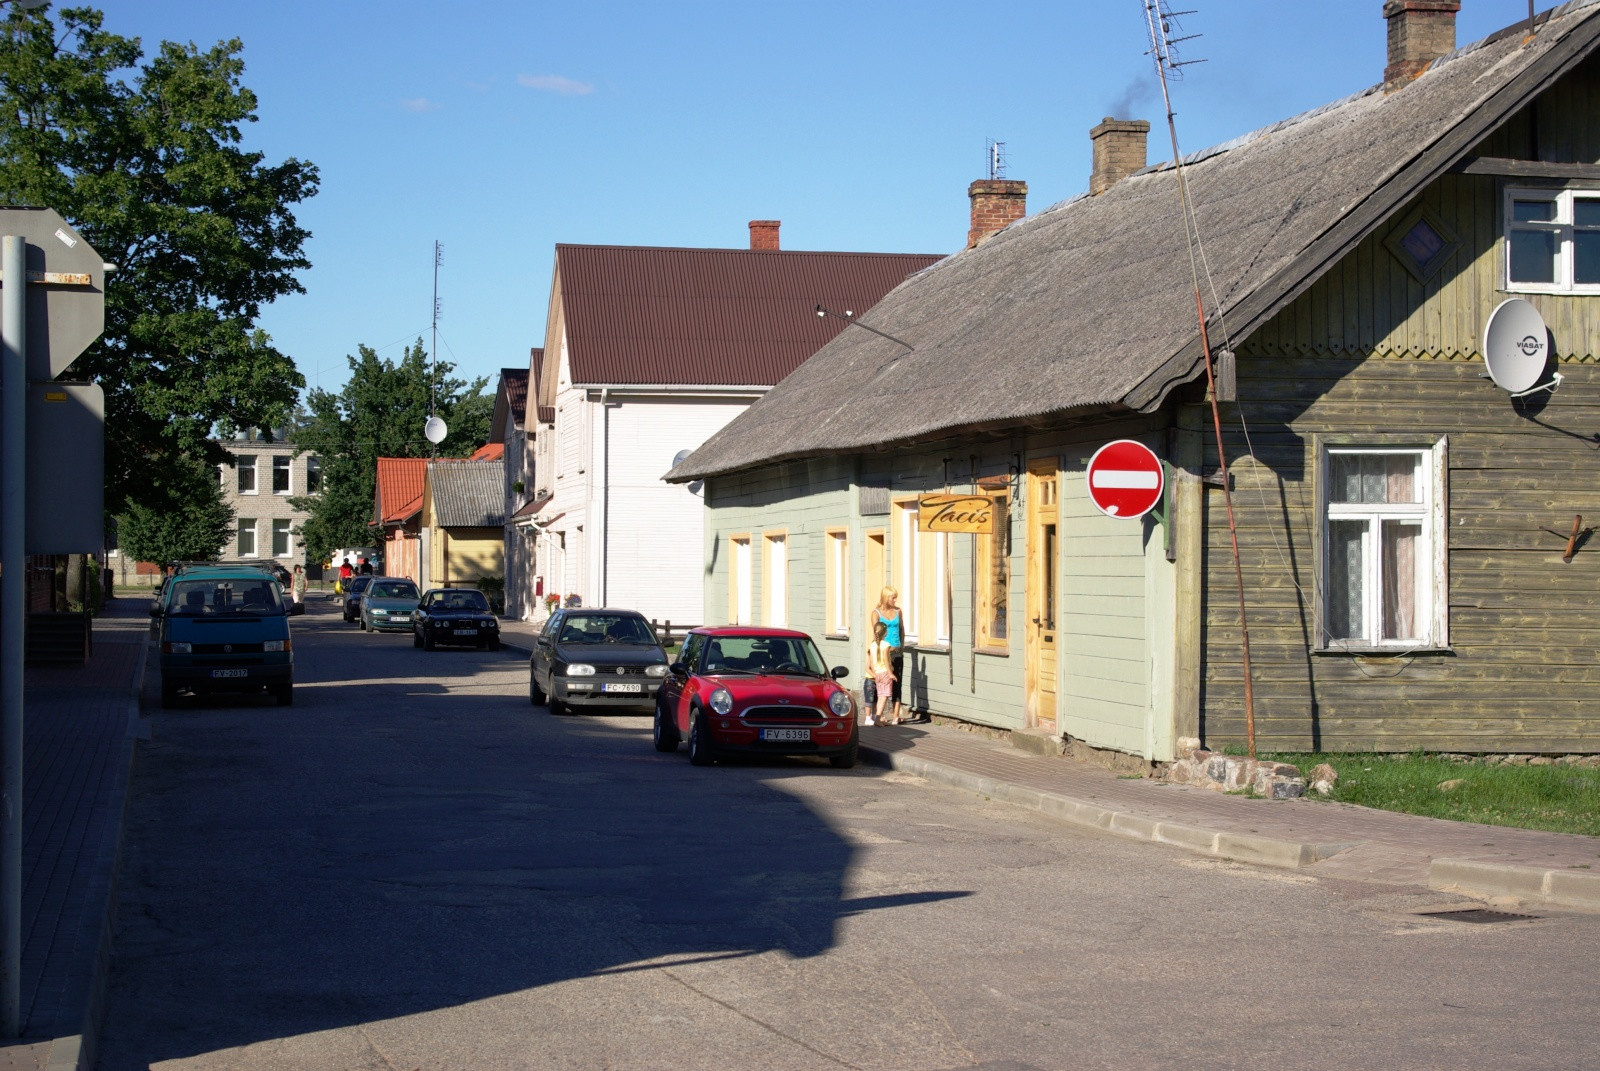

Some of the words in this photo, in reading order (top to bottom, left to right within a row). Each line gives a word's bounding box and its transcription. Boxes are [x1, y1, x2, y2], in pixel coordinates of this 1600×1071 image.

[1516, 341, 1544, 350] VIASAT
[920, 496, 993, 529] Tacis
[214, 669, 247, 678] FV-2017
[607, 684, 640, 692] FC-7690
[766, 730, 809, 739] FV-6396
